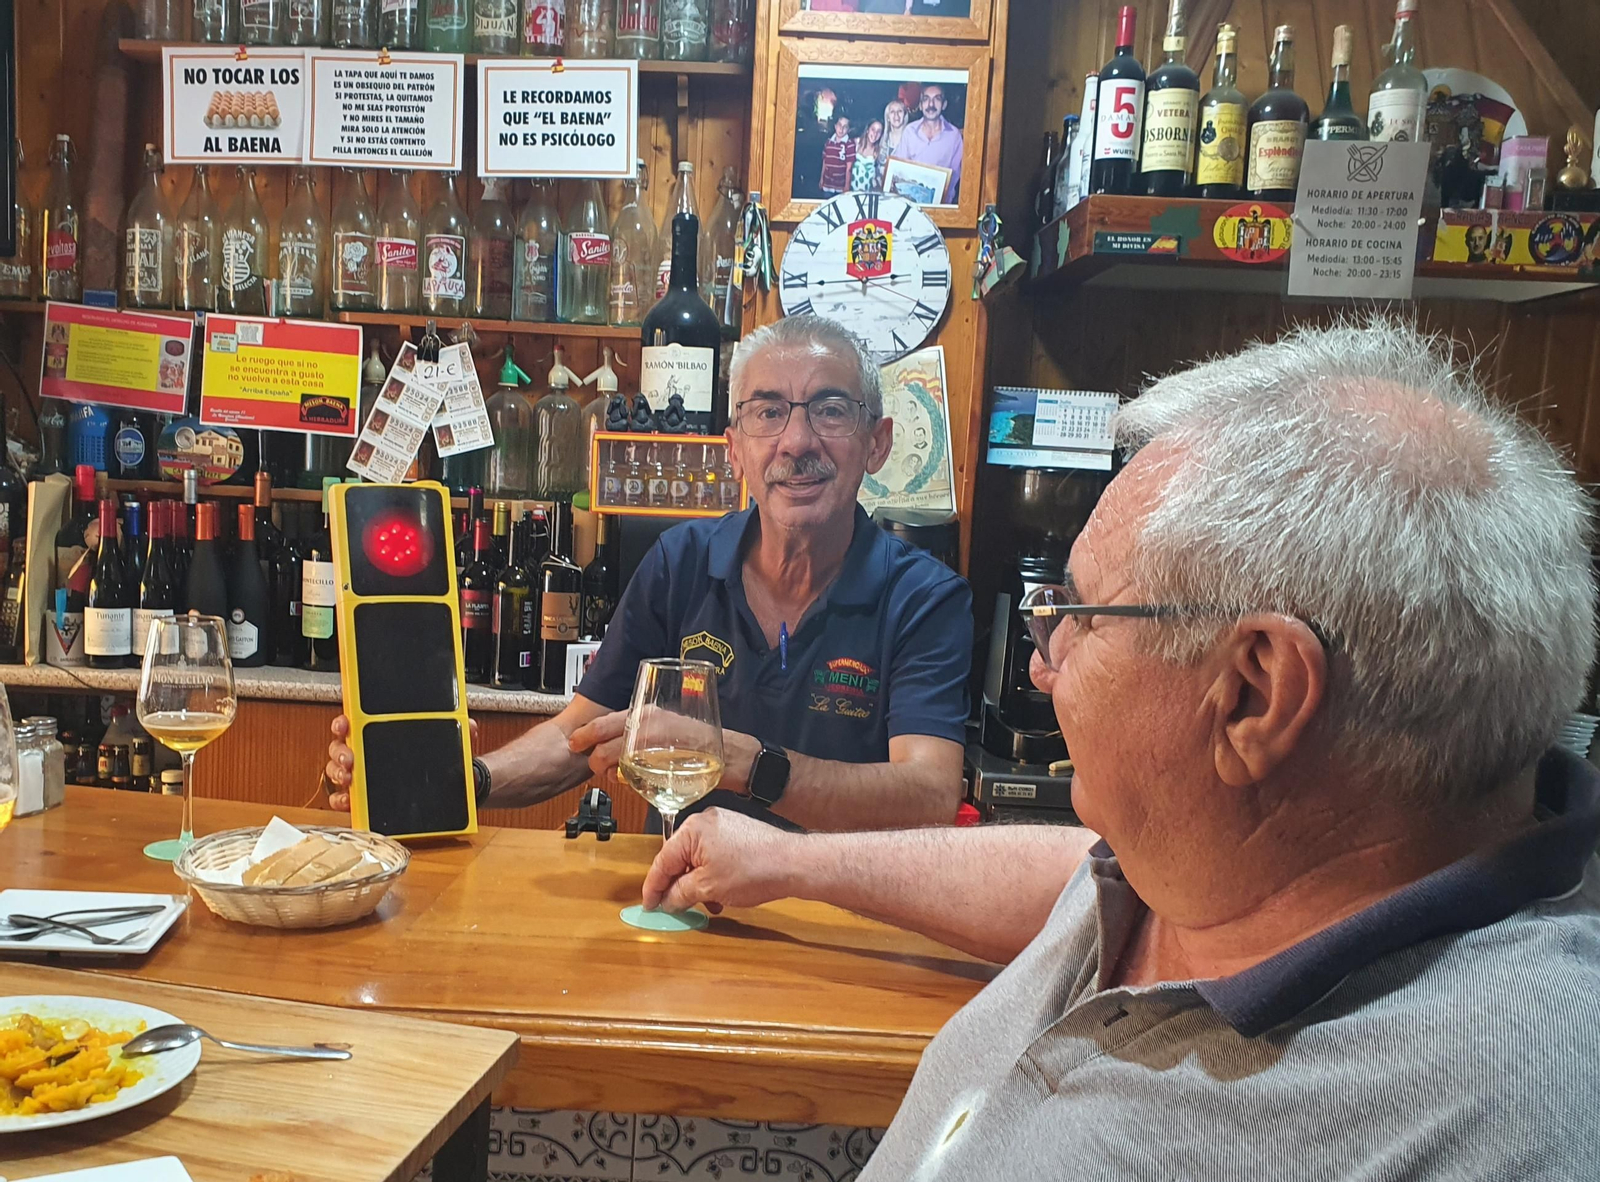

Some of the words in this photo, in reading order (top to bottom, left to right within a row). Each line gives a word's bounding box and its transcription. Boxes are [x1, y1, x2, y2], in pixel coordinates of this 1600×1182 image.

[184, 68, 207, 85] NO
[212, 68, 264, 85] TOCAR
[270, 68, 300, 85] LOS
[334, 70, 342, 78] LA
[344, 70, 362, 78] TAPA
[364, 71, 378, 80] QUE
[380, 69, 398, 80] AQUÍ
[399, 72, 407, 80] TE
[409, 72, 434, 80] DAMOS
[343, 81, 354, 89] UN
[356, 82, 390, 90] OBSEQUIO
[407, 82, 434, 92] PATRÓN
[335, 92, 342, 100] SI
[344, 92, 384, 102] PROTESTAS,
[396, 94, 432, 102] QUITAMOS
[503, 90, 516, 104] LE
[522, 90, 612, 104] RECORDAMOS
[367, 104, 382, 112] SEAS
[385, 104, 425, 113] PROTESTÓN
[1110, 86, 1136, 139] 5
[350, 114, 360, 122] NO
[395, 114, 424, 124] TAMAÑO
[503, 112, 530, 126] QUE
[382, 126, 390, 134] LA
[392, 126, 425, 135] ATENCIÓN
[500, 132, 518, 146] NO
[522, 132, 537, 146] ES
[541, 129, 616, 146] PSICÓLOGO
[203, 136, 222, 152] AL
[228, 137, 282, 153] BAENA
[356, 136, 366, 144] NO
[368, 136, 388, 144] ESTÁS
[390, 138, 426, 146] CONTENTO
[332, 146, 352, 154] PILLA
[354, 147, 388, 155] ENTONCES
[390, 148, 398, 156] EL
[400, 147, 432, 157] CALLEJÓN
[1307, 190, 1348, 200] HORARIO
[1352, 190, 1363, 200] DE
[1366, 190, 1414, 200] APERTURA
[816, 200, 847, 235] XI
[895, 203, 912, 230] I
[1312, 205, 1352, 216] Mediodía:
[1358, 207, 1378, 216] 11:30
[1386, 208, 1408, 216] 17:00
[1318, 219, 1346, 228] Noche:
[1352, 220, 1376, 230] 20:00
[1383, 221, 1406, 230] 24:00
[794, 230, 820, 256] X
[913, 232, 944, 258] II
[1306, 238, 1348, 248] HORARIO
[1351, 240, 1363, 248] DE
[1366, 240, 1402, 250] COCINA
[1307, 254, 1348, 264] Mediodía:
[1352, 256, 1374, 265] 13:00
[1382, 256, 1402, 266] 15:45
[782, 268, 808, 290] IX
[922, 268, 948, 289] III
[1313, 266, 1342, 277] Noche:
[1346, 268, 1372, 278] 20:00
[1380, 268, 1402, 278] 23:15
[234, 276, 258, 292] SELECTA
[236, 354, 247, 363] Le
[250, 355, 275, 367] ruego
[278, 359, 298, 368] que
[300, 358, 306, 368] si
[307, 360, 318, 368] no
[645, 360, 674, 370] RAMÓN
[676, 362, 708, 371] BILBAO
[230, 364, 240, 372] se
[242, 365, 288, 377] encuentra
[291, 369, 296, 377] a
[299, 370, 324, 380] gusto
[228, 372, 239, 382] no
[242, 373, 270, 384] vuelva
[272, 376, 278, 384] a
[280, 376, 300, 386] esta
[302, 379, 324, 388] casa
[705, 636, 728, 654] BAENA
[154, 672, 214, 684] MONTECILLO
[828, 672, 864, 688] MENI
